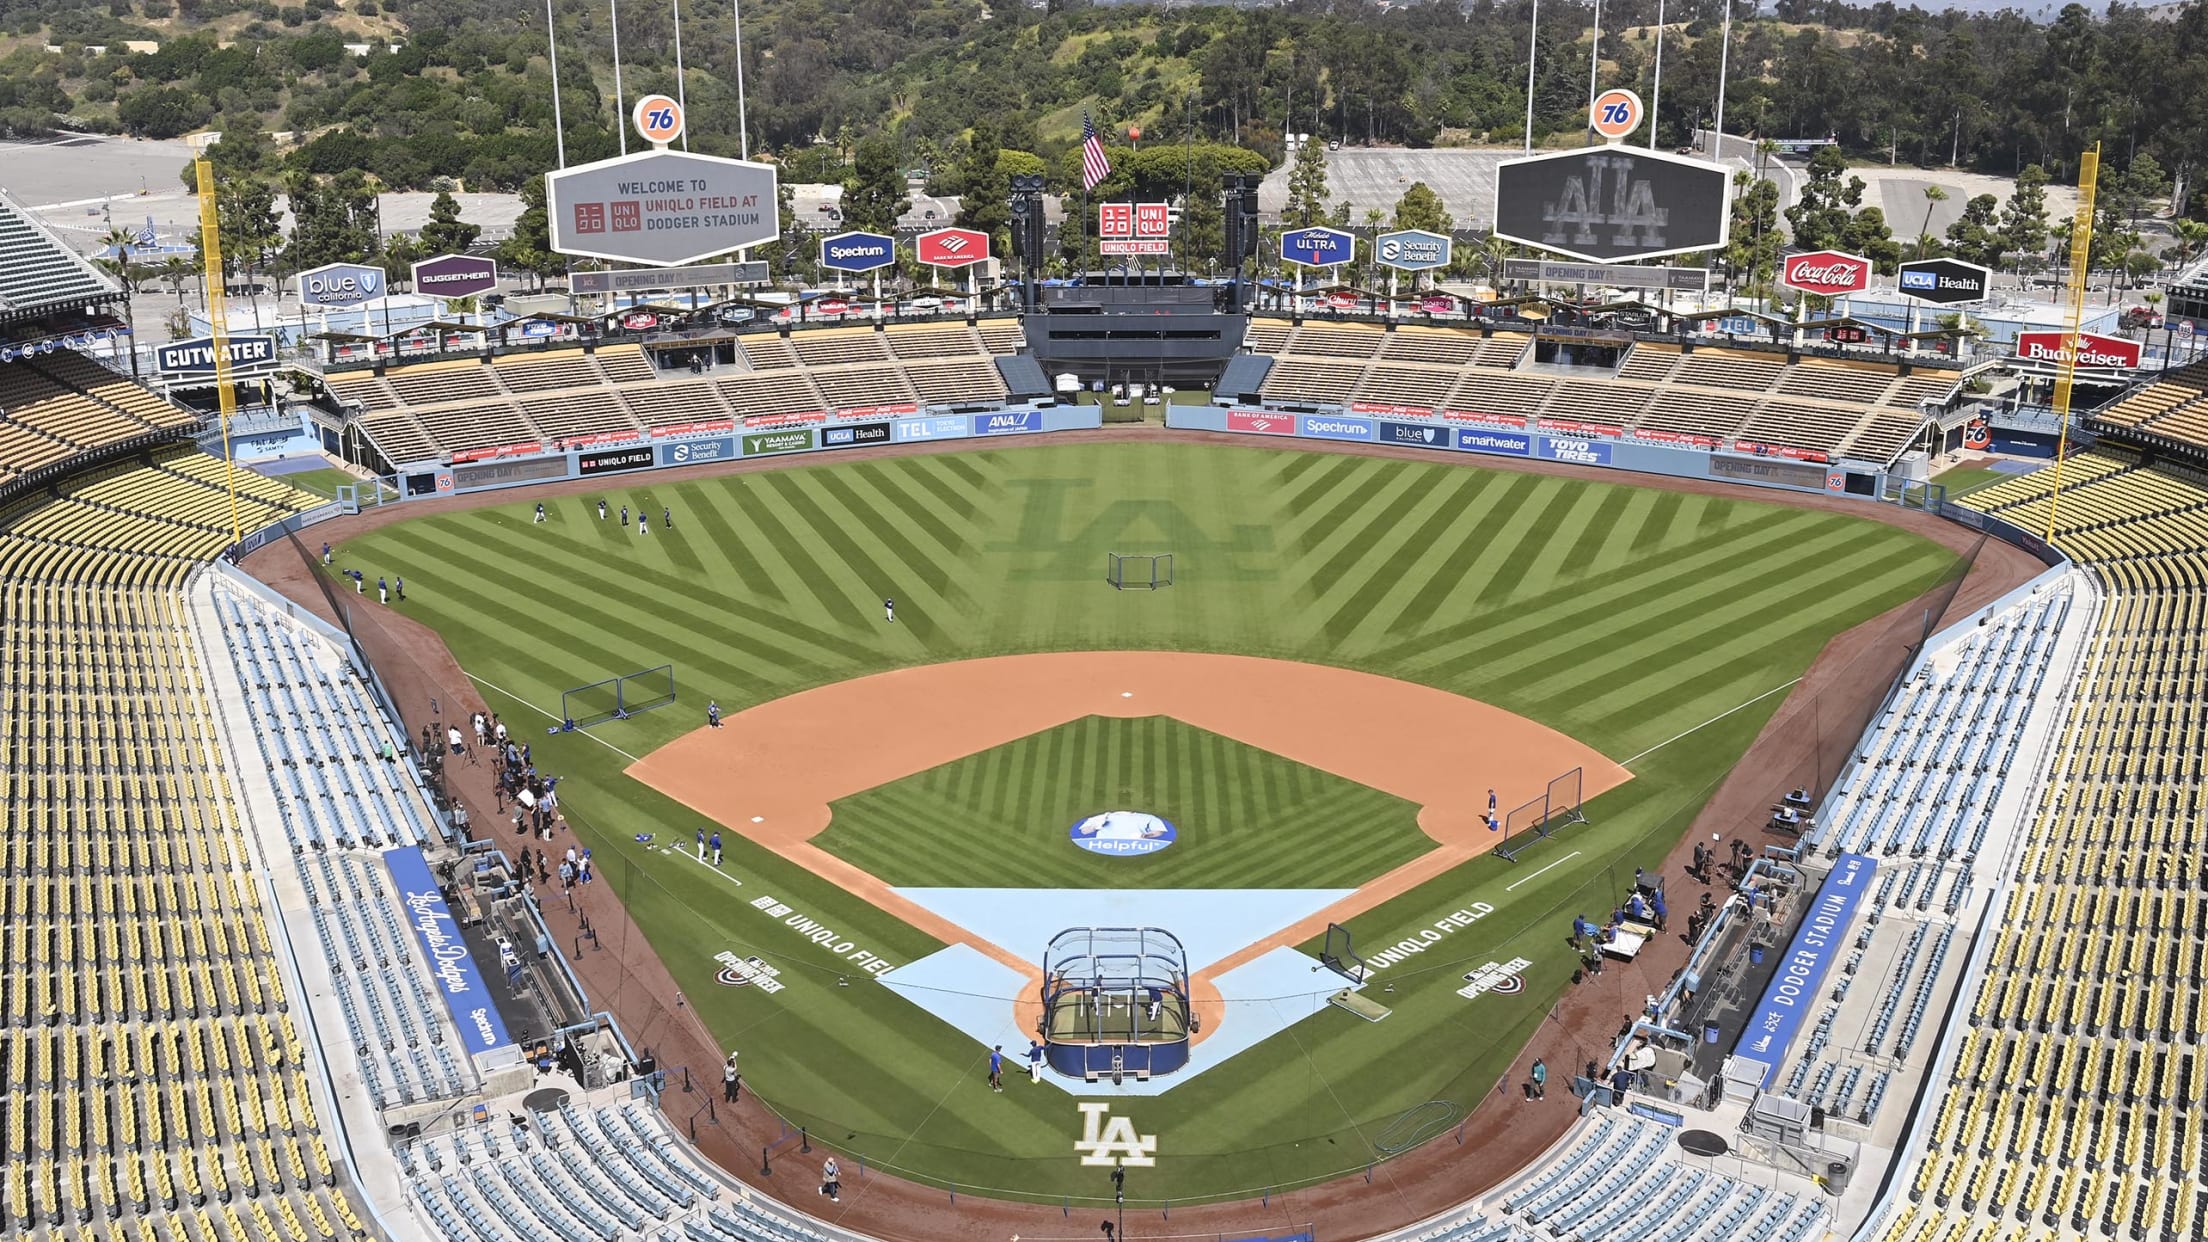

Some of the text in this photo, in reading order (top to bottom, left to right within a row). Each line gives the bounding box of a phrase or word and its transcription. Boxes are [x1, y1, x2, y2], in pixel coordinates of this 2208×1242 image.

[648, 108, 675, 129] 76
[1602, 102, 1629, 123] 76
[618, 179, 706, 194] WELCOME TO
[646, 195, 758, 213] UNIQLO FIELD AT
[647, 213, 759, 230] DODGER STADIUM
[1104, 244, 1164, 252] UNIQLO FIELD
[1297, 239, 1336, 250] ULTRA
[1403, 240, 1442, 252] Security
[830, 246, 884, 260] Spectrum
[1404, 251, 1438, 262] Benefit
[422, 271, 490, 284] GUGGENHEIM
[616, 273, 655, 288] OPENING
[658, 272, 675, 284] DAY
[1545, 266, 1585, 280] OPENING
[1588, 269, 1606, 281] DAY
[1791, 261, 1860, 287] Coca-Cola
[309, 275, 356, 294] blue
[1904, 274, 1979, 290] UCLA Health
[317, 291, 362, 302] california
[1725, 318, 1750, 331] TEL
[165, 341, 266, 368] CUTWATER
[988, 415, 1015, 427] ANA
[1307, 419, 1363, 435] Spectrum
[829, 428, 885, 441] UCLA Health
[901, 422, 930, 437] TEL
[1396, 426, 1422, 438] blue
[691, 441, 721, 451] Security
[1462, 434, 1526, 450] smartwater
[1549, 438, 1589, 450] TOYO
[598, 456, 627, 466] UNIQLO
[628, 453, 651, 463] FIELD
[691, 449, 718, 460] Benefit
[1555, 450, 1597, 462] TIRES
[440, 478, 450, 487] 76
[457, 468, 495, 483] OPENING
[497, 467, 512, 479] DAY
[1830, 477, 1841, 487] 76
[1088, 840, 1153, 852] Helpful
[1366, 901, 1495, 969] UNIQLO FIELD
[784, 914, 897, 977] UNIQLO FIEL
[1773, 949, 1819, 1006] DODGER
[1805, 893, 1848, 947] STADIUM
[434, 945, 470, 993] Dodgers
[470, 1007, 495, 1042] Spectrum
[1074, 1102, 1157, 1167] LA
